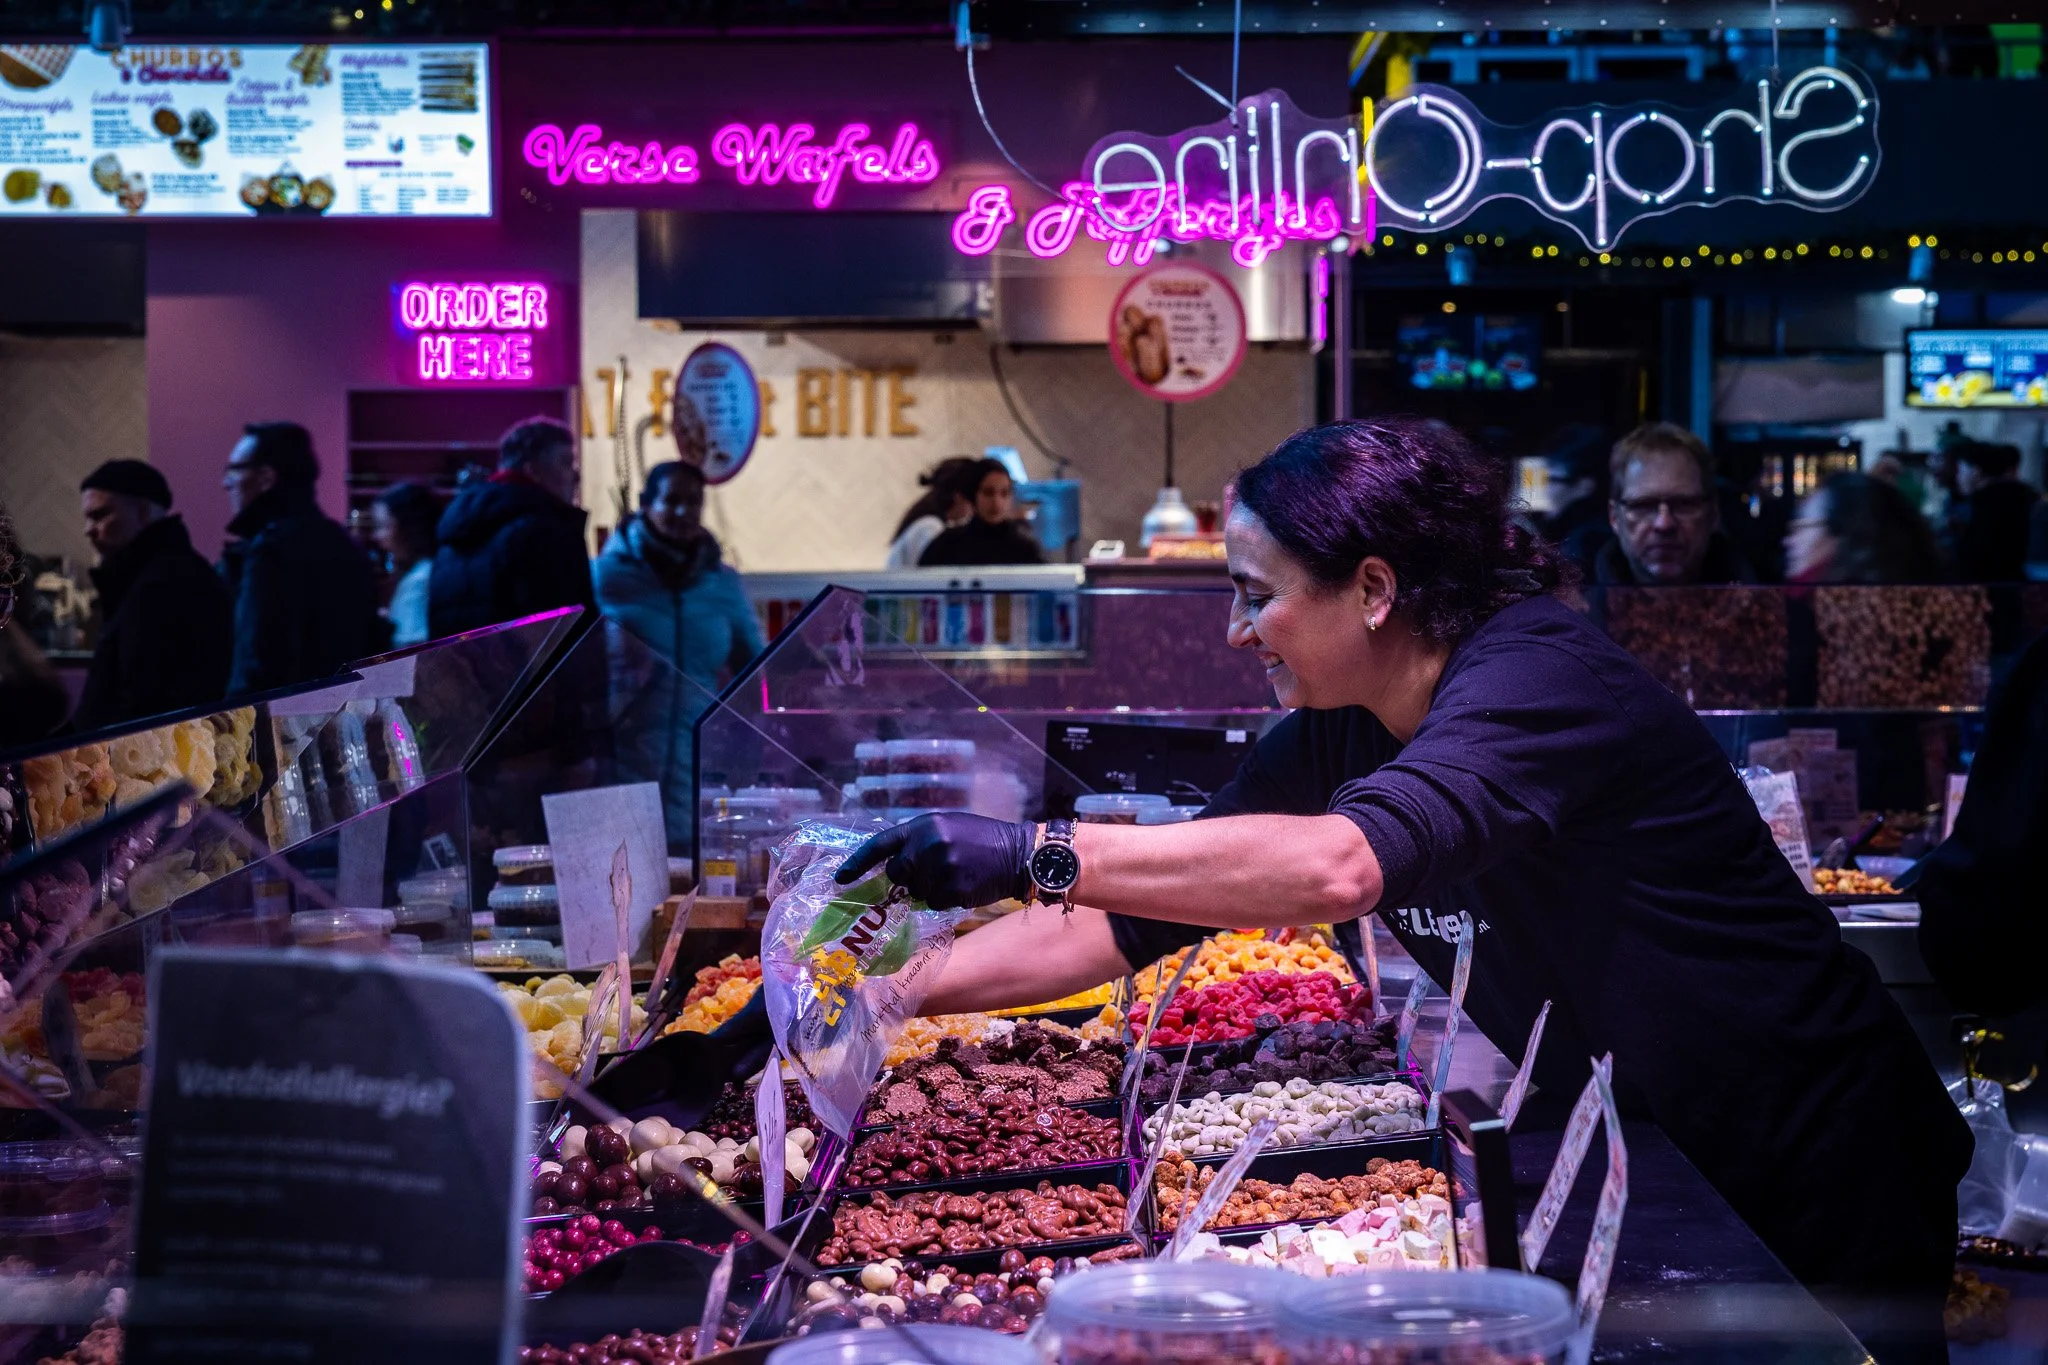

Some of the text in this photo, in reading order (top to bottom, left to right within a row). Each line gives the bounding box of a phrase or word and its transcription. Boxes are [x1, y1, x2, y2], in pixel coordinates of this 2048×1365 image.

[523, 122, 939, 208] Verse Wafels
[401, 282, 548, 328] ORDER
[418, 333, 533, 380] HERE
[796, 365, 920, 437] BITE
[860, 985, 903, 1043] Markthal
